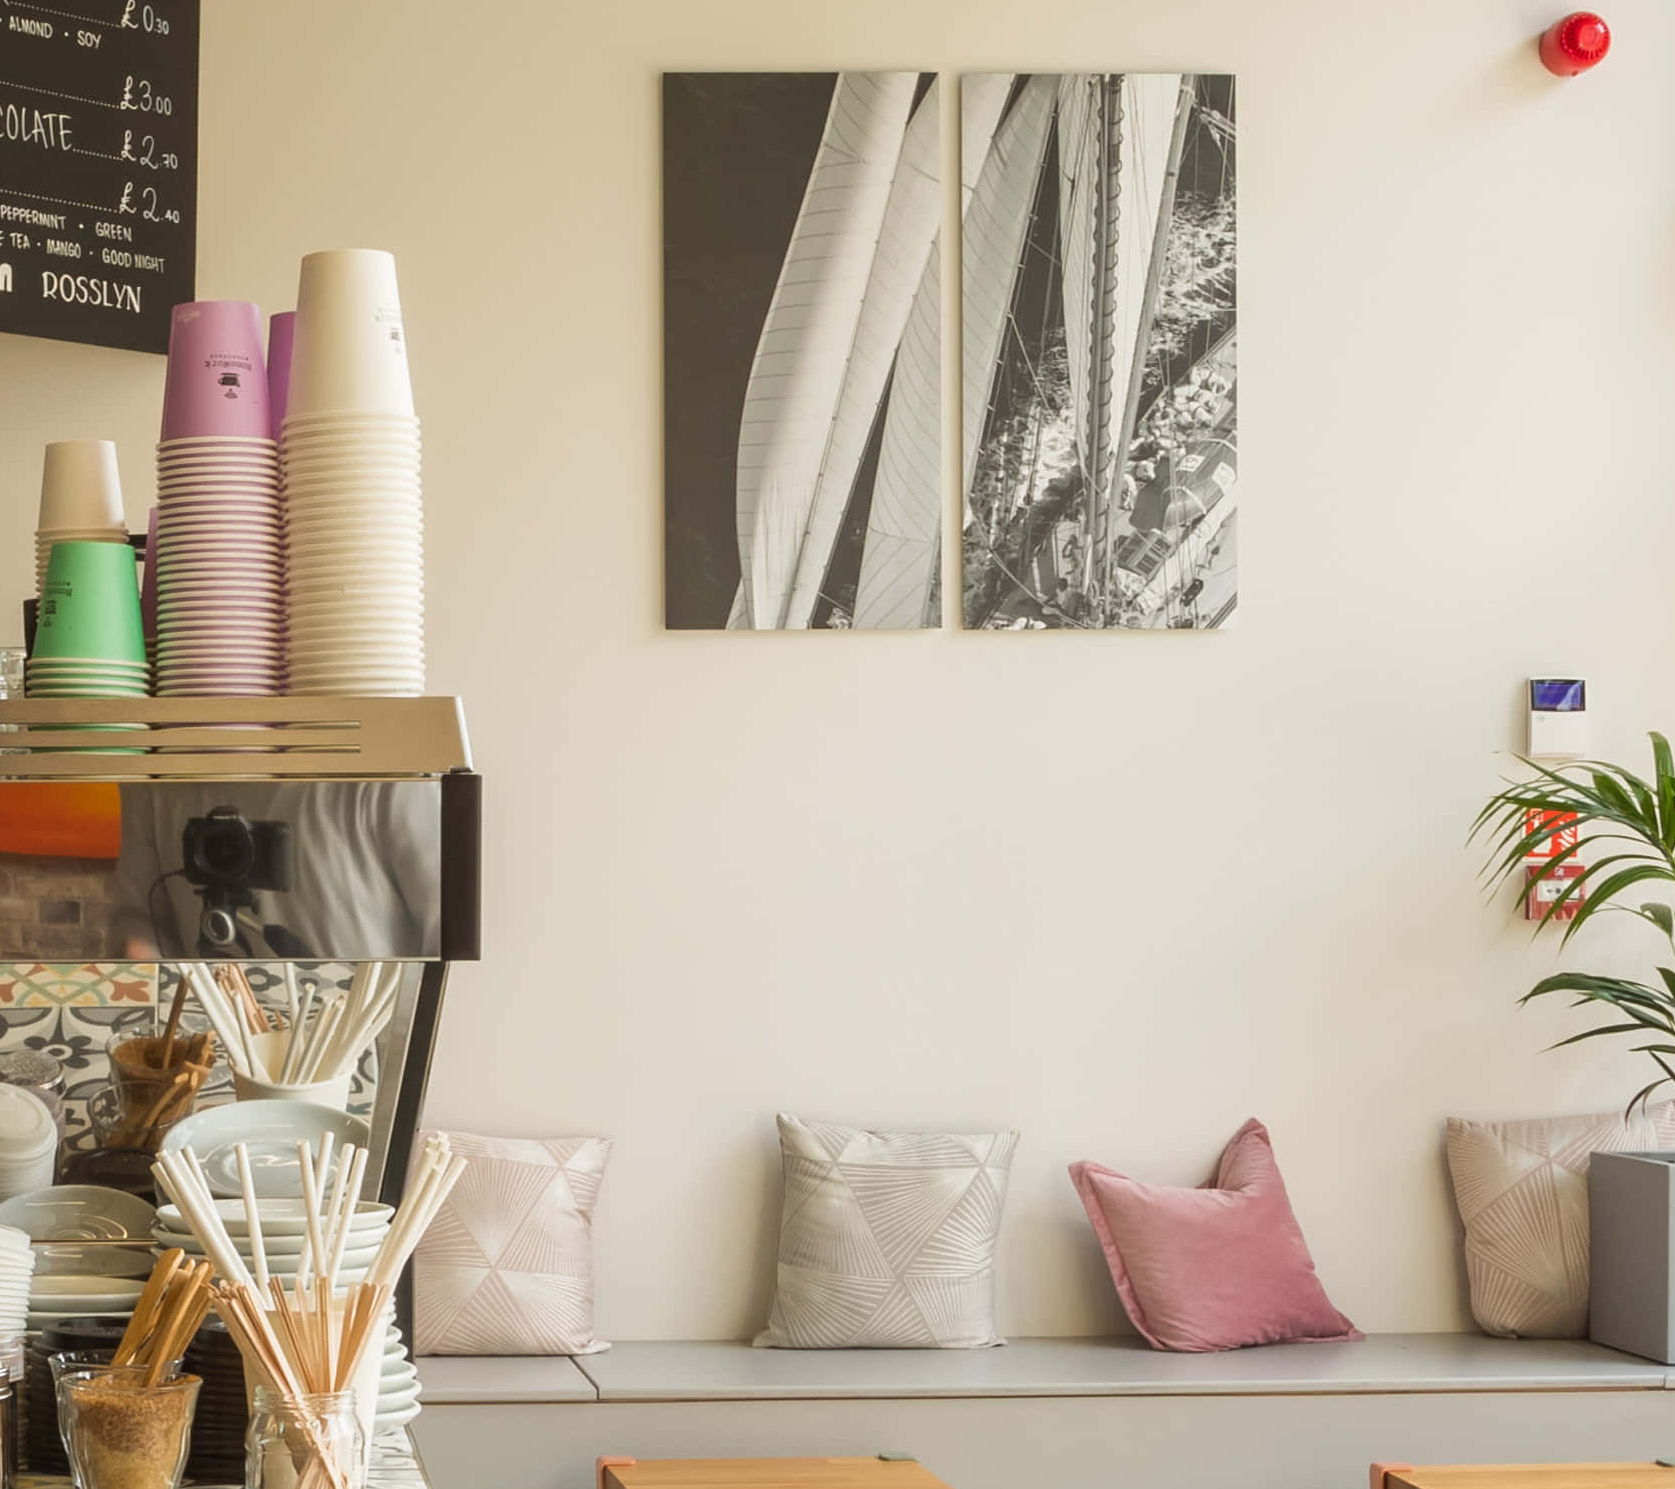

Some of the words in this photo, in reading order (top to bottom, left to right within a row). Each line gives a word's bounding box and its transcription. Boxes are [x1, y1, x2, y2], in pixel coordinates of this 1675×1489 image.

[8, 15, 54, 39] ALMOND
[76, 30, 102, 49] SOY
[0, 204, 67, 231] PEPPERMINT
[94, 222, 133, 243] GREEN
[9, 232, 31, 250] TEA
[46, 239, 82, 259] MANGO
[41, 270, 142, 313] ROSSLYN
